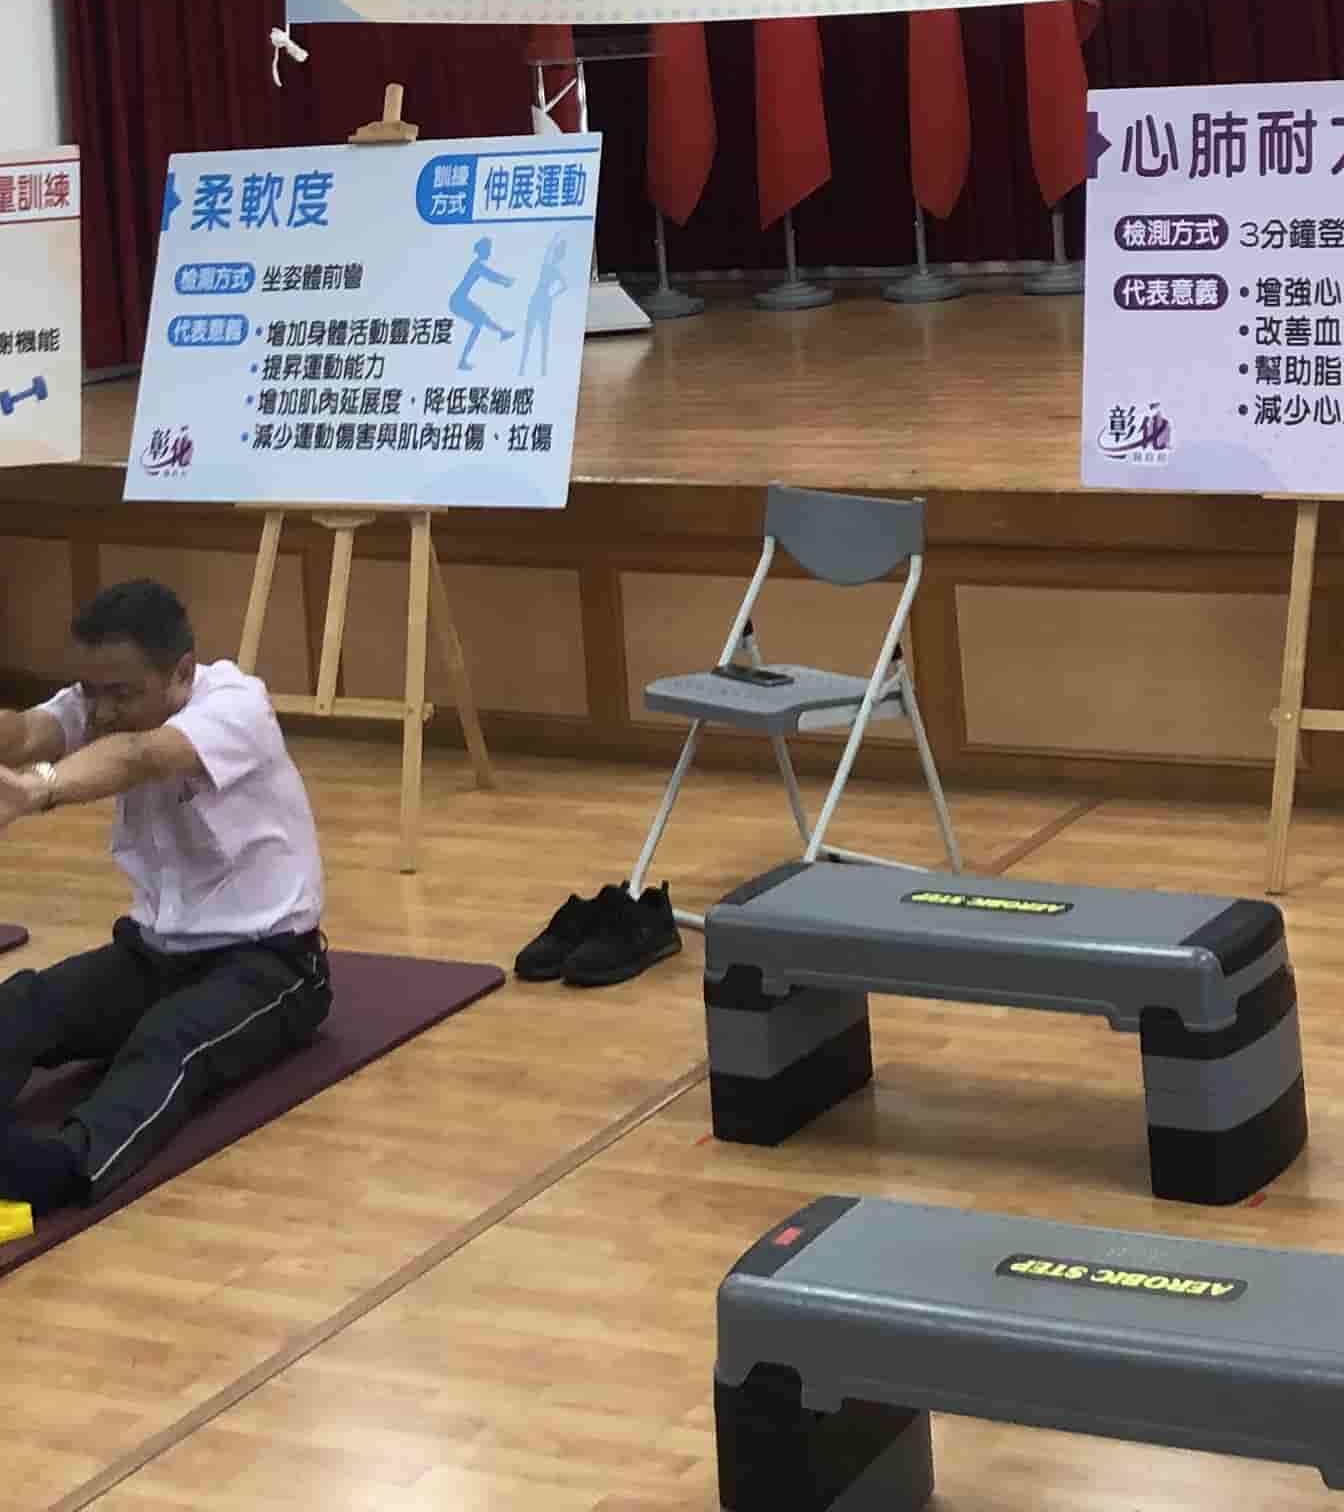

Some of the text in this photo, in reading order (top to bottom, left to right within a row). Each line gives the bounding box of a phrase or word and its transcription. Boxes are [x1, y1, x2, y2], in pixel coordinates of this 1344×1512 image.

[190, 169, 335, 231] 柔軟度
[484, 163, 588, 211] 伸展運動
[1122, 218, 1220, 247] 檢測方式
[1121, 278, 1219, 306] 代表意義
[1010, 1259, 1234, 1296] AEROBIC STEP
